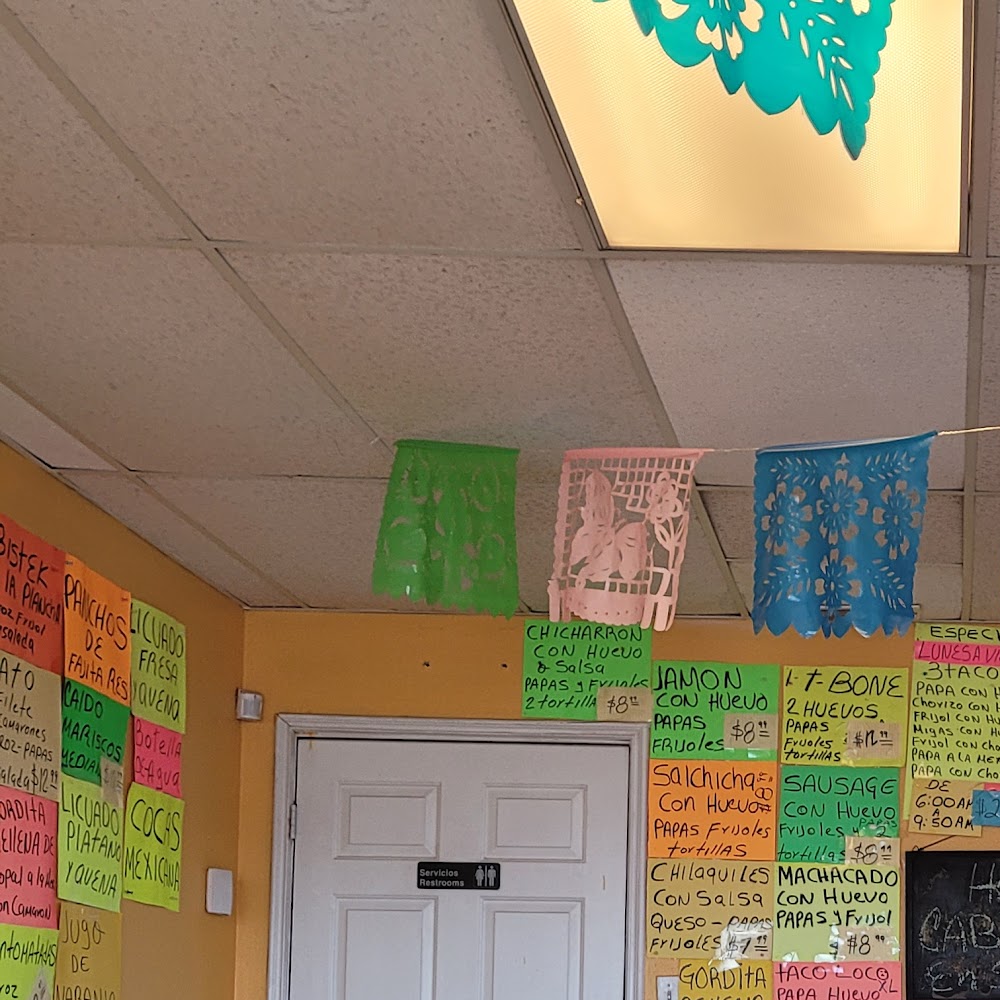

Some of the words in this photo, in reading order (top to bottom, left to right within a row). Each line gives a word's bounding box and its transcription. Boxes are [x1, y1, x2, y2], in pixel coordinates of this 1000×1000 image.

[65, 574, 128, 651] PANCHOS
[527, 625, 642, 641] CHICHARRON
[86, 629, 103, 661] DE
[534, 645, 575, 659] CON
[919, 642, 970, 660] LUNES
[971, 648, 981, 660] A
[139, 650, 178, 686] FRESA
[555, 659, 604, 674] Salsa
[69, 652, 103, 682] FAJITA
[107, 667, 128, 701] RES
[525, 679, 569, 692] PAPAS
[653, 666, 742, 691] JAMON
[916, 681, 955, 697] PAPA
[961, 686, 987, 698] CON
[656, 692, 698, 708] CON
[787, 698, 799, 715] 2
[804, 704, 879, 719] HUEVOS
[913, 698, 962, 709] Chorizo
[968, 700, 992, 712] CON
[654, 715, 706, 730] PAPAS
[956, 713, 980, 724] CON
[786, 722, 829, 734] PAPAS
[913, 725, 953, 736] MIGAS
[960, 726, 981, 736] CON
[62, 718, 121, 763] MARISCOS
[912, 737, 949, 747] Frijol
[956, 740, 977, 749] CON
[912, 749, 941, 762] PAPA
[947, 752, 956, 762] A
[653, 764, 755, 791] Salchicha
[911, 764, 942, 779] PAPA
[950, 768, 972, 778] CON
[784, 777, 897, 799] SAUSAGE
[925, 780, 951, 792] DE
[659, 792, 695, 812] Con
[784, 802, 825, 817] CON
[62, 794, 119, 836] LICUADO
[131, 799, 180, 851] COCAS
[654, 818, 699, 839] PAPAS
[706, 819, 771, 840] Frijoles
[66, 820, 121, 862] PLATANO
[125, 847, 180, 892] MEXICANA
[420, 869, 458, 877] Servicios
[779, 867, 898, 887] MACHACADO
[420, 879, 464, 887] Restrooms
[653, 889, 690, 907] CON
[698, 890, 764, 908] Salsa
[777, 891, 814, 906] CON
[650, 913, 705, 932] QUESO
[777, 911, 827, 928] PAPAS
[845, 910, 891, 926] Frijol
[62, 910, 105, 950] JUGO
[71, 954, 90, 973] DE
[679, 964, 766, 990] GORDITA
[777, 964, 827, 982] TACO
